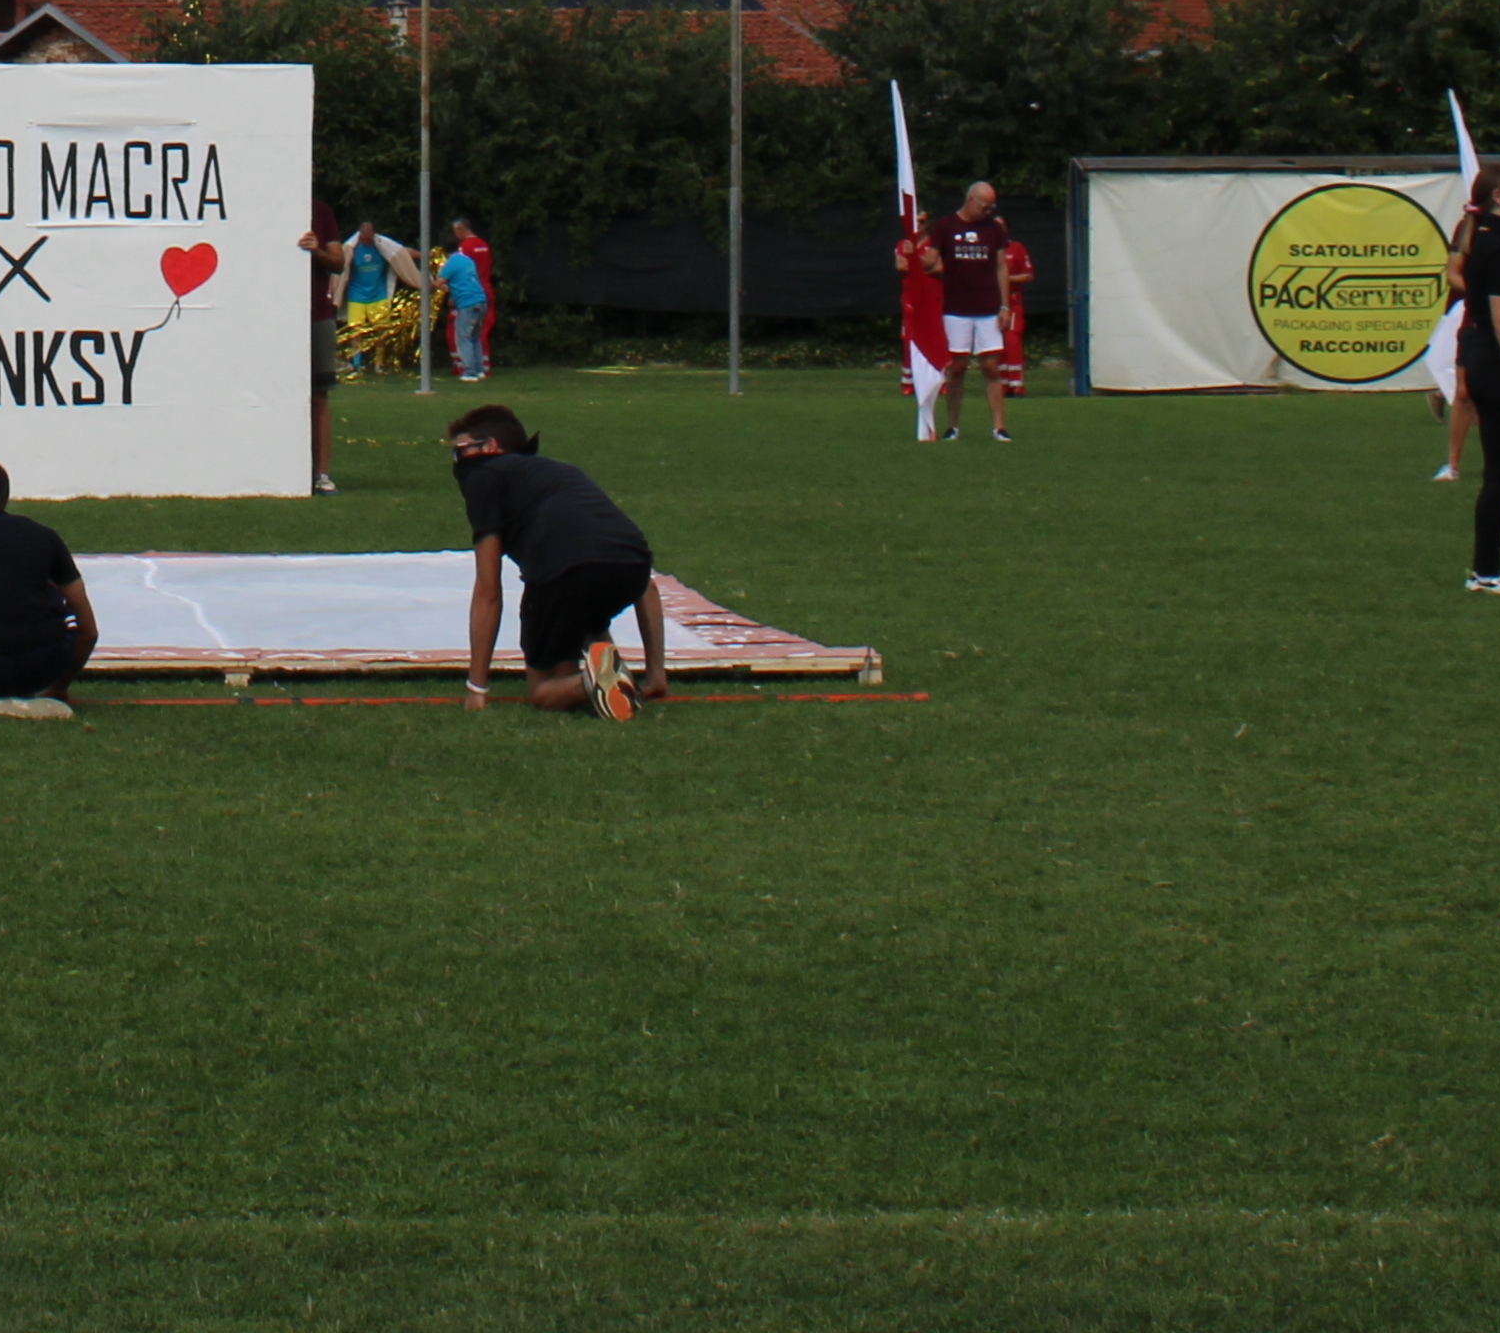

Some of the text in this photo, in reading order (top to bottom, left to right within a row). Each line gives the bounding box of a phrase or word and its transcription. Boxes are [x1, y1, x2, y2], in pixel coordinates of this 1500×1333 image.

[41, 141, 227, 221] MACRA
[1289, 244, 1420, 258] SCATOLIFICIO
[1259, 282, 1426, 310] PACK service
[1273, 318, 1433, 332] PACKAGING SPECIALIST
[1300, 339, 1406, 354] RACCONIGI
